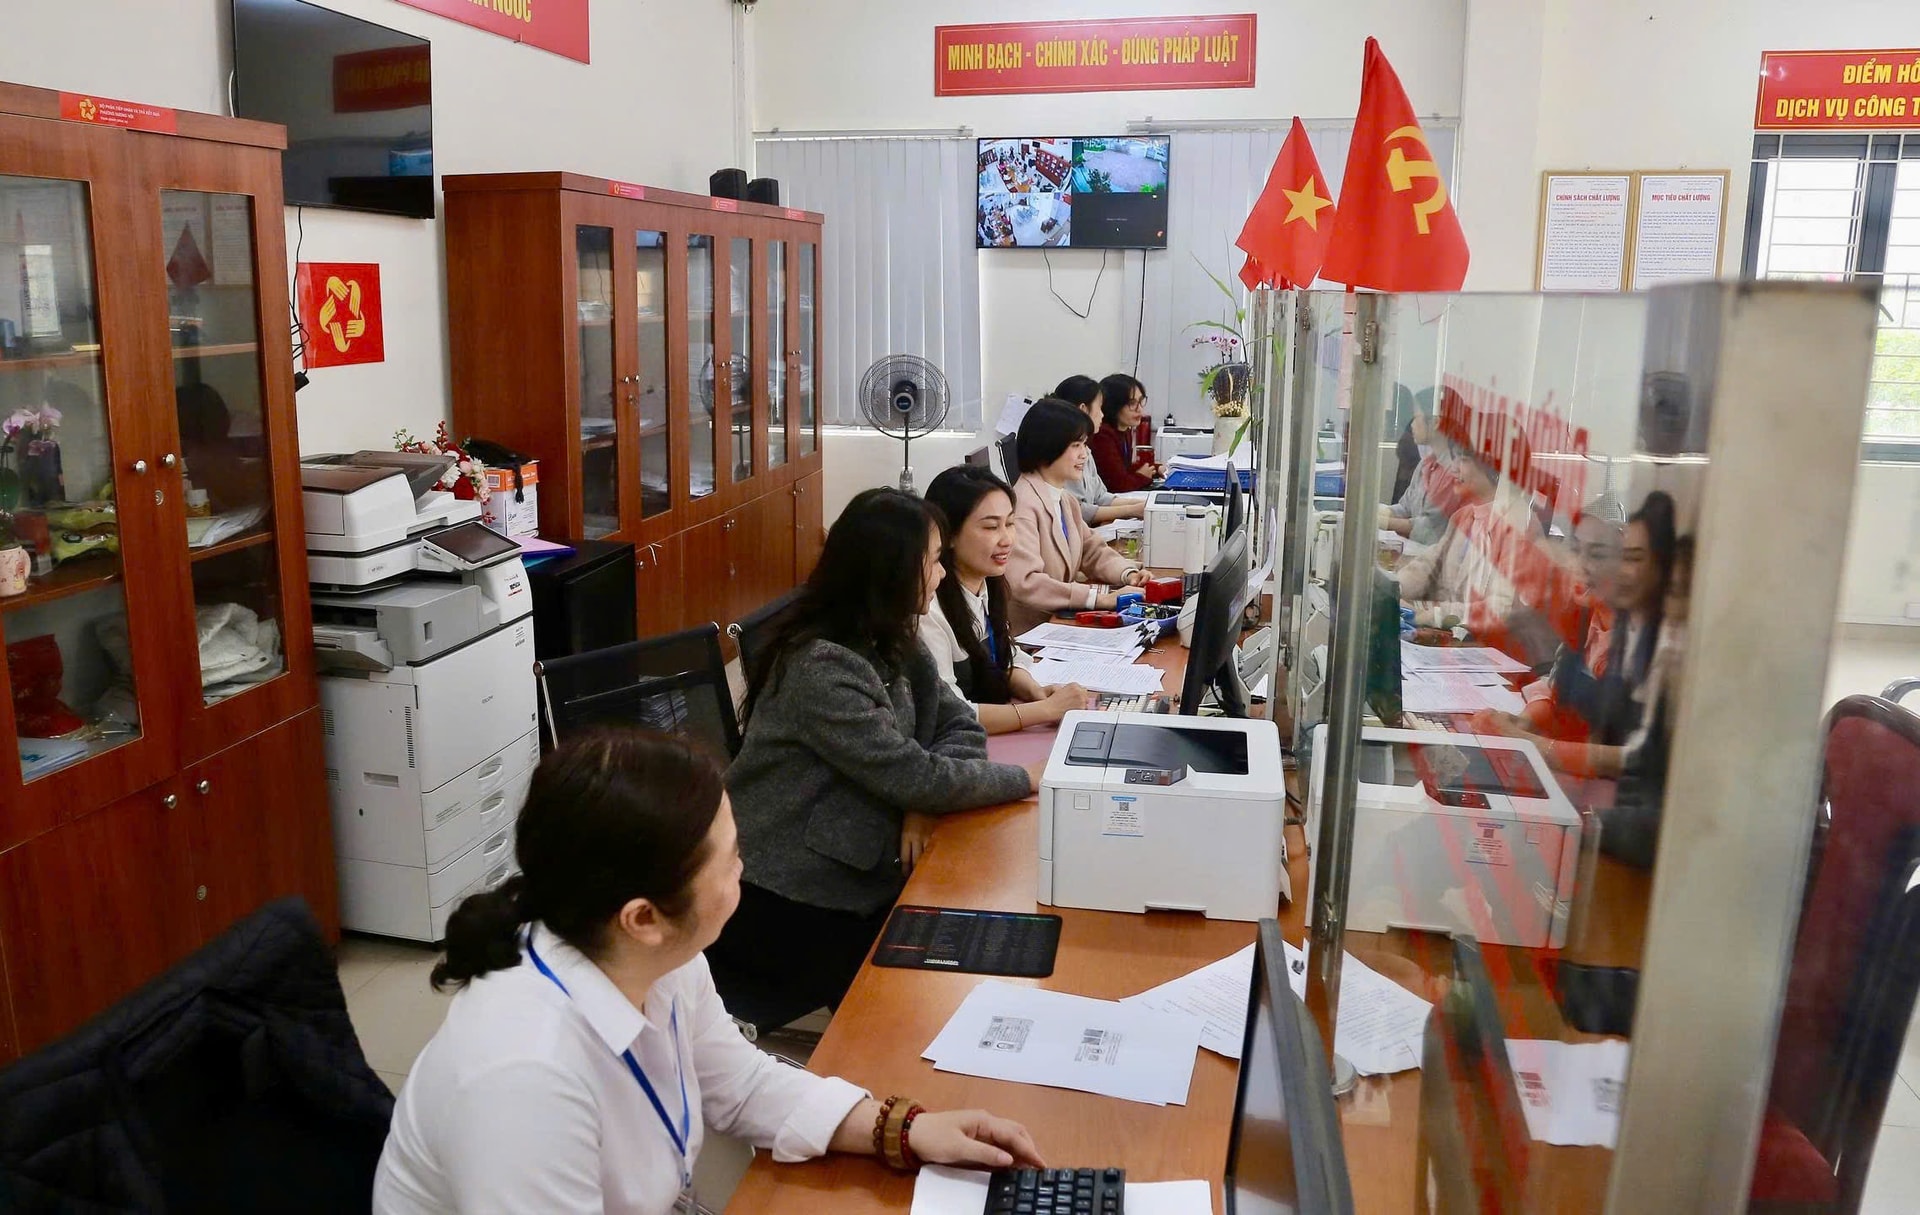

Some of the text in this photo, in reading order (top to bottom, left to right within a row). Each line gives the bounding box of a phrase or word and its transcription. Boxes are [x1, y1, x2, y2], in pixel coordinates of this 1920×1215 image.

[948, 44, 983, 71] MINH
[986, 42, 1022, 74] BẠCH
[1035, 35, 1076, 68] CHÍNH
[1080, 34, 1108, 66] XÁC
[1121, 33, 1159, 65] ĐÚNG
[1163, 30, 1200, 63] PHÁP
[1204, 30, 1239, 67] LUẬT
[1843, 57, 1920, 84] ĐIỂM HỖ
[1775, 95, 1920, 120] DỊCH VỤ CÔNG T
[1573, 193, 1588, 201] SÁCH
[1588, 193, 1602, 201] CHẤT
[1603, 193, 1621, 202] LƯỢNG
[1652, 194, 1664, 202] MỤC
[1678, 193, 1692, 201] CHẤT
[1693, 193, 1711, 202] LƯỢNG
